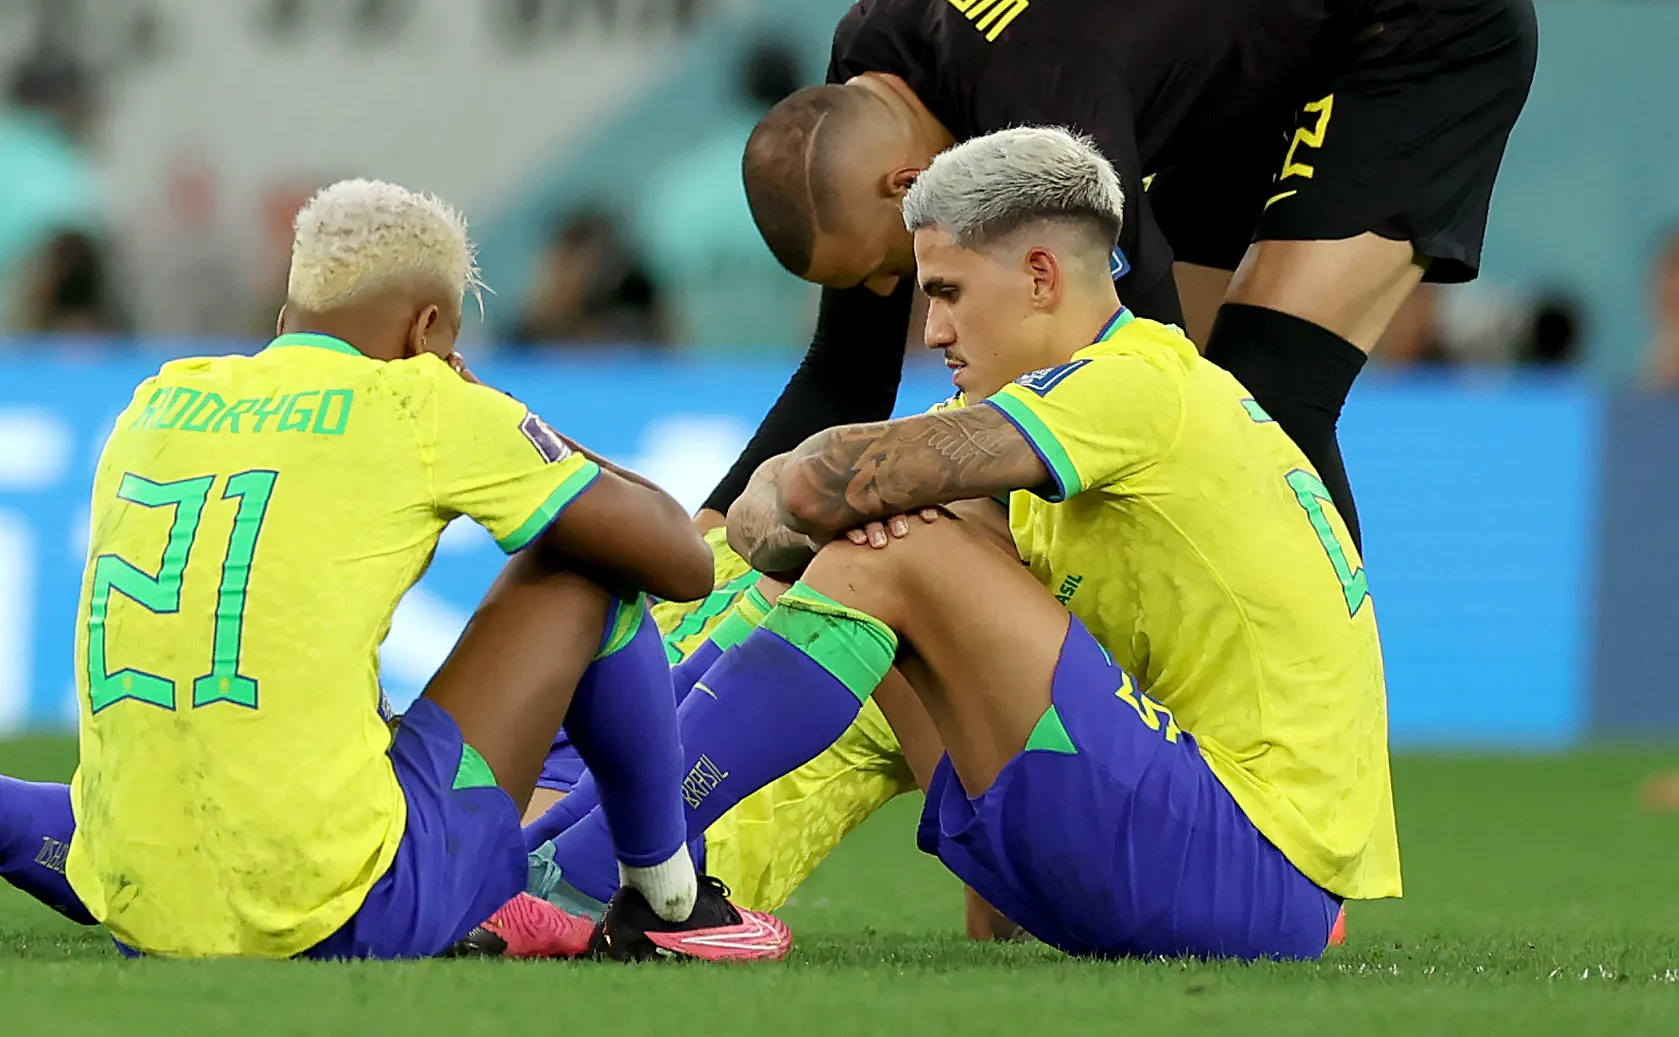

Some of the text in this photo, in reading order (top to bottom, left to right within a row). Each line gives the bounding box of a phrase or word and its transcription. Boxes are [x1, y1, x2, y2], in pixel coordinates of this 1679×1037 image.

[129, 387, 354, 435] RODRYGO
[87, 469, 279, 716] 21
[1055, 575, 1083, 606] ASIL
[680, 753, 729, 810] BRASIL
